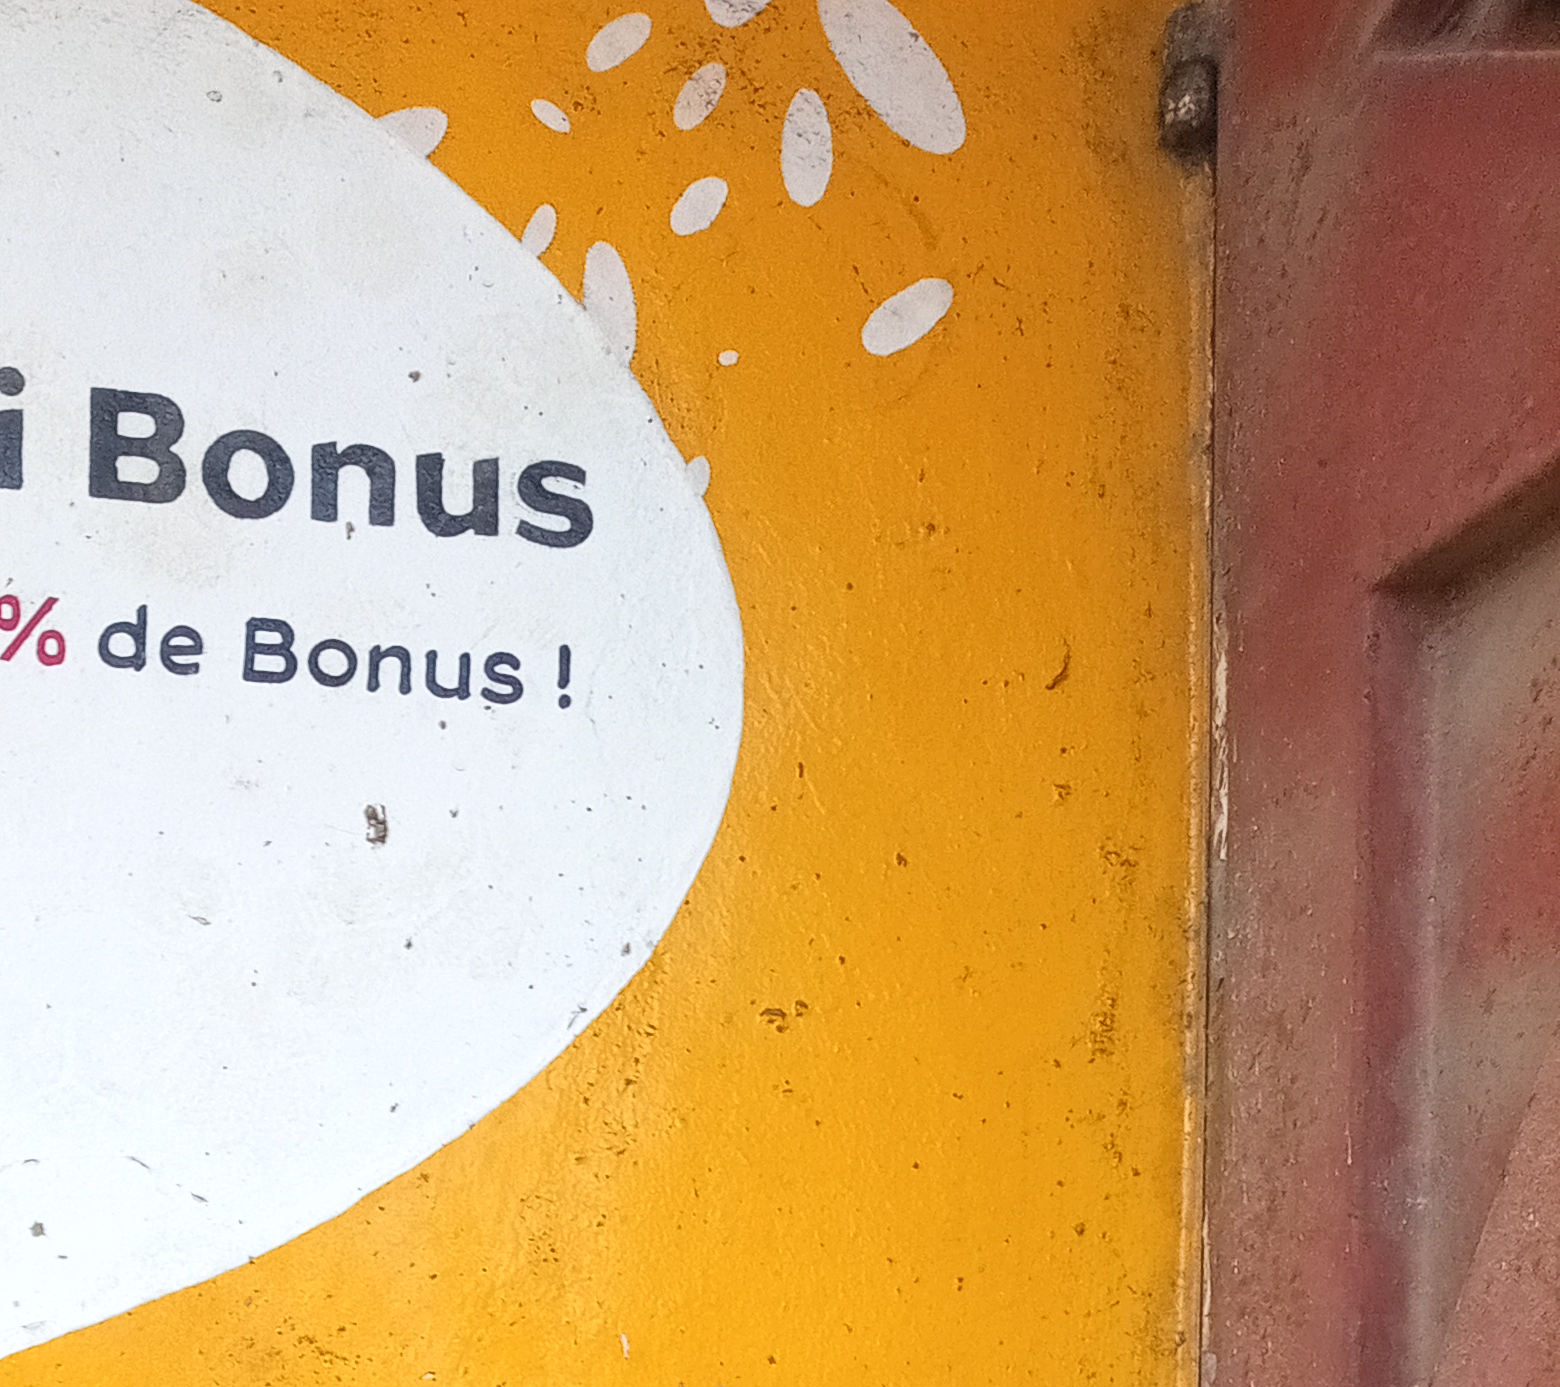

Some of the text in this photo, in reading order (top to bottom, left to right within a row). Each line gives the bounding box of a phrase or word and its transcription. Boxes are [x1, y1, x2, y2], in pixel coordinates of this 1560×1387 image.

[87, 386, 595, 550] Bonus
[97, 603, 205, 677] de
[241, 615, 525, 706] Bonus
[556, 643, 573, 711] !
